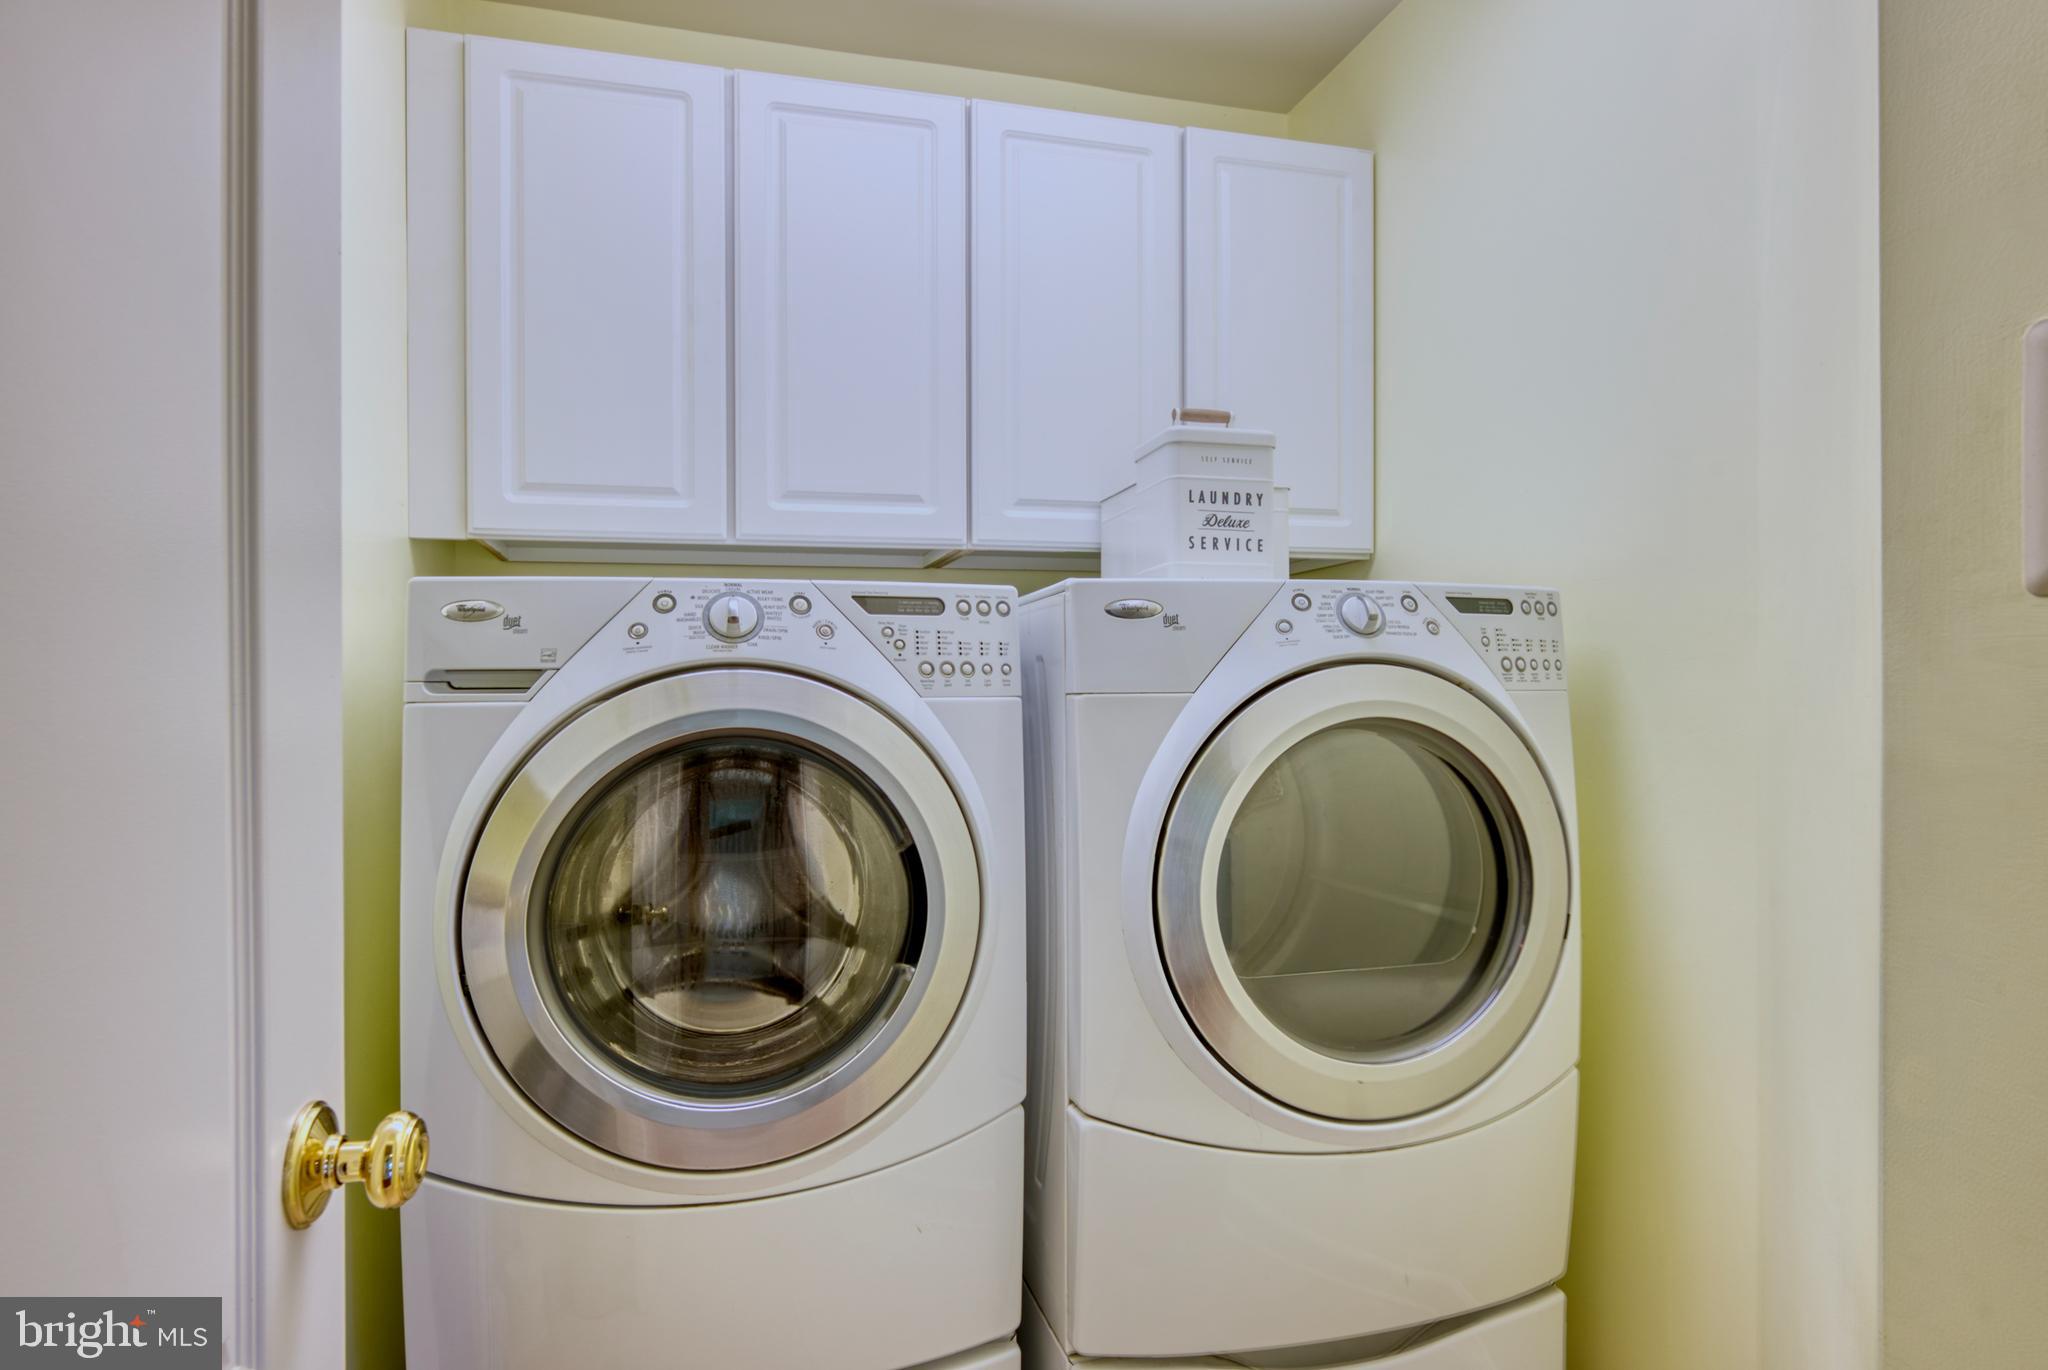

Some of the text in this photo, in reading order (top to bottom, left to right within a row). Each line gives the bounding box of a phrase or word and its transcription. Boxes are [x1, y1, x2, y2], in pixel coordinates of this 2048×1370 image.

[1188, 489, 1264, 507] LAUNDRY
[1202, 513, 1250, 529] Deluxe
[1188, 535, 1264, 553] SERVICE
[503, 613, 521, 631] duet
[1163, 613, 1179, 628] duet
